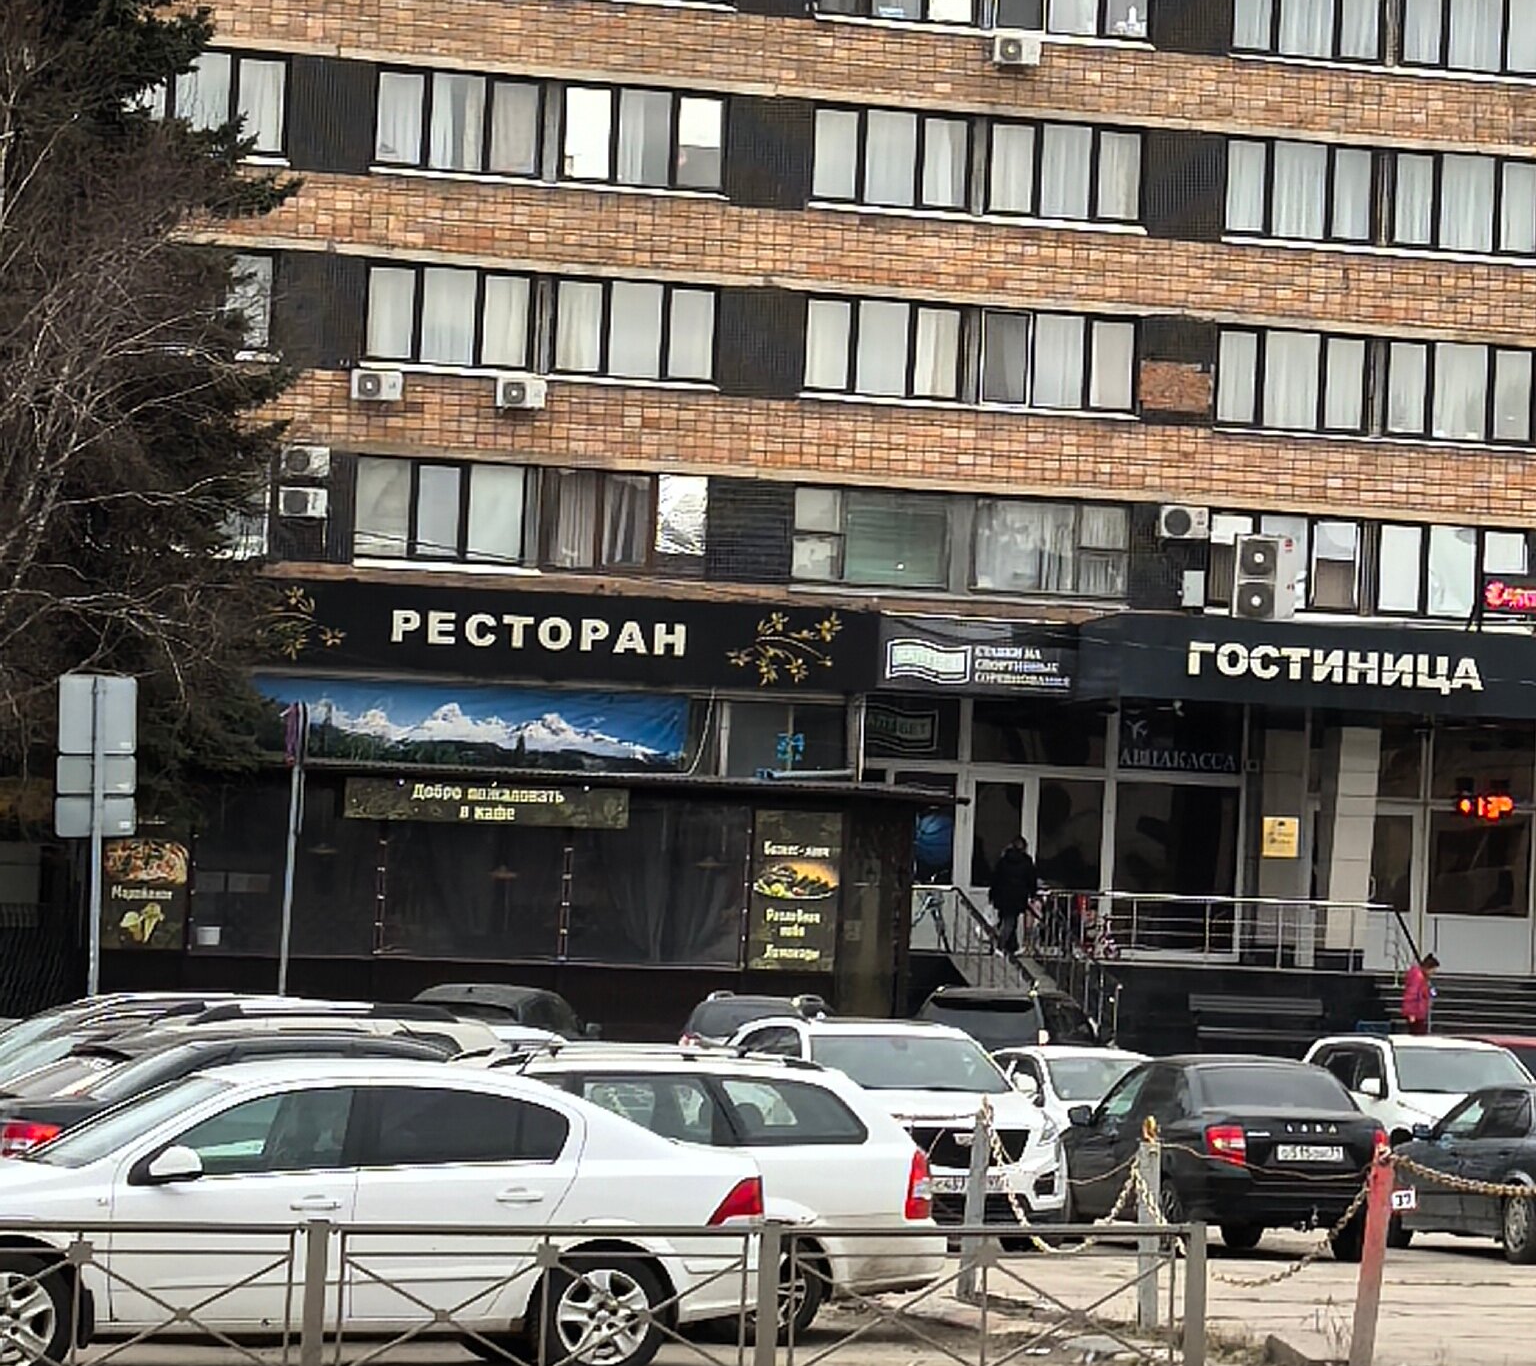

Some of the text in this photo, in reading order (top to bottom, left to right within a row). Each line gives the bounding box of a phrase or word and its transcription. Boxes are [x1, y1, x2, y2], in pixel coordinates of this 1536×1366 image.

[391, 609, 687, 657] РЕСТОРАН
[1187, 641, 1484, 695] ГОСТИНИЦА
[411, 783, 566, 804] Добро пожаловать
[474, 805, 516, 821] кафе
